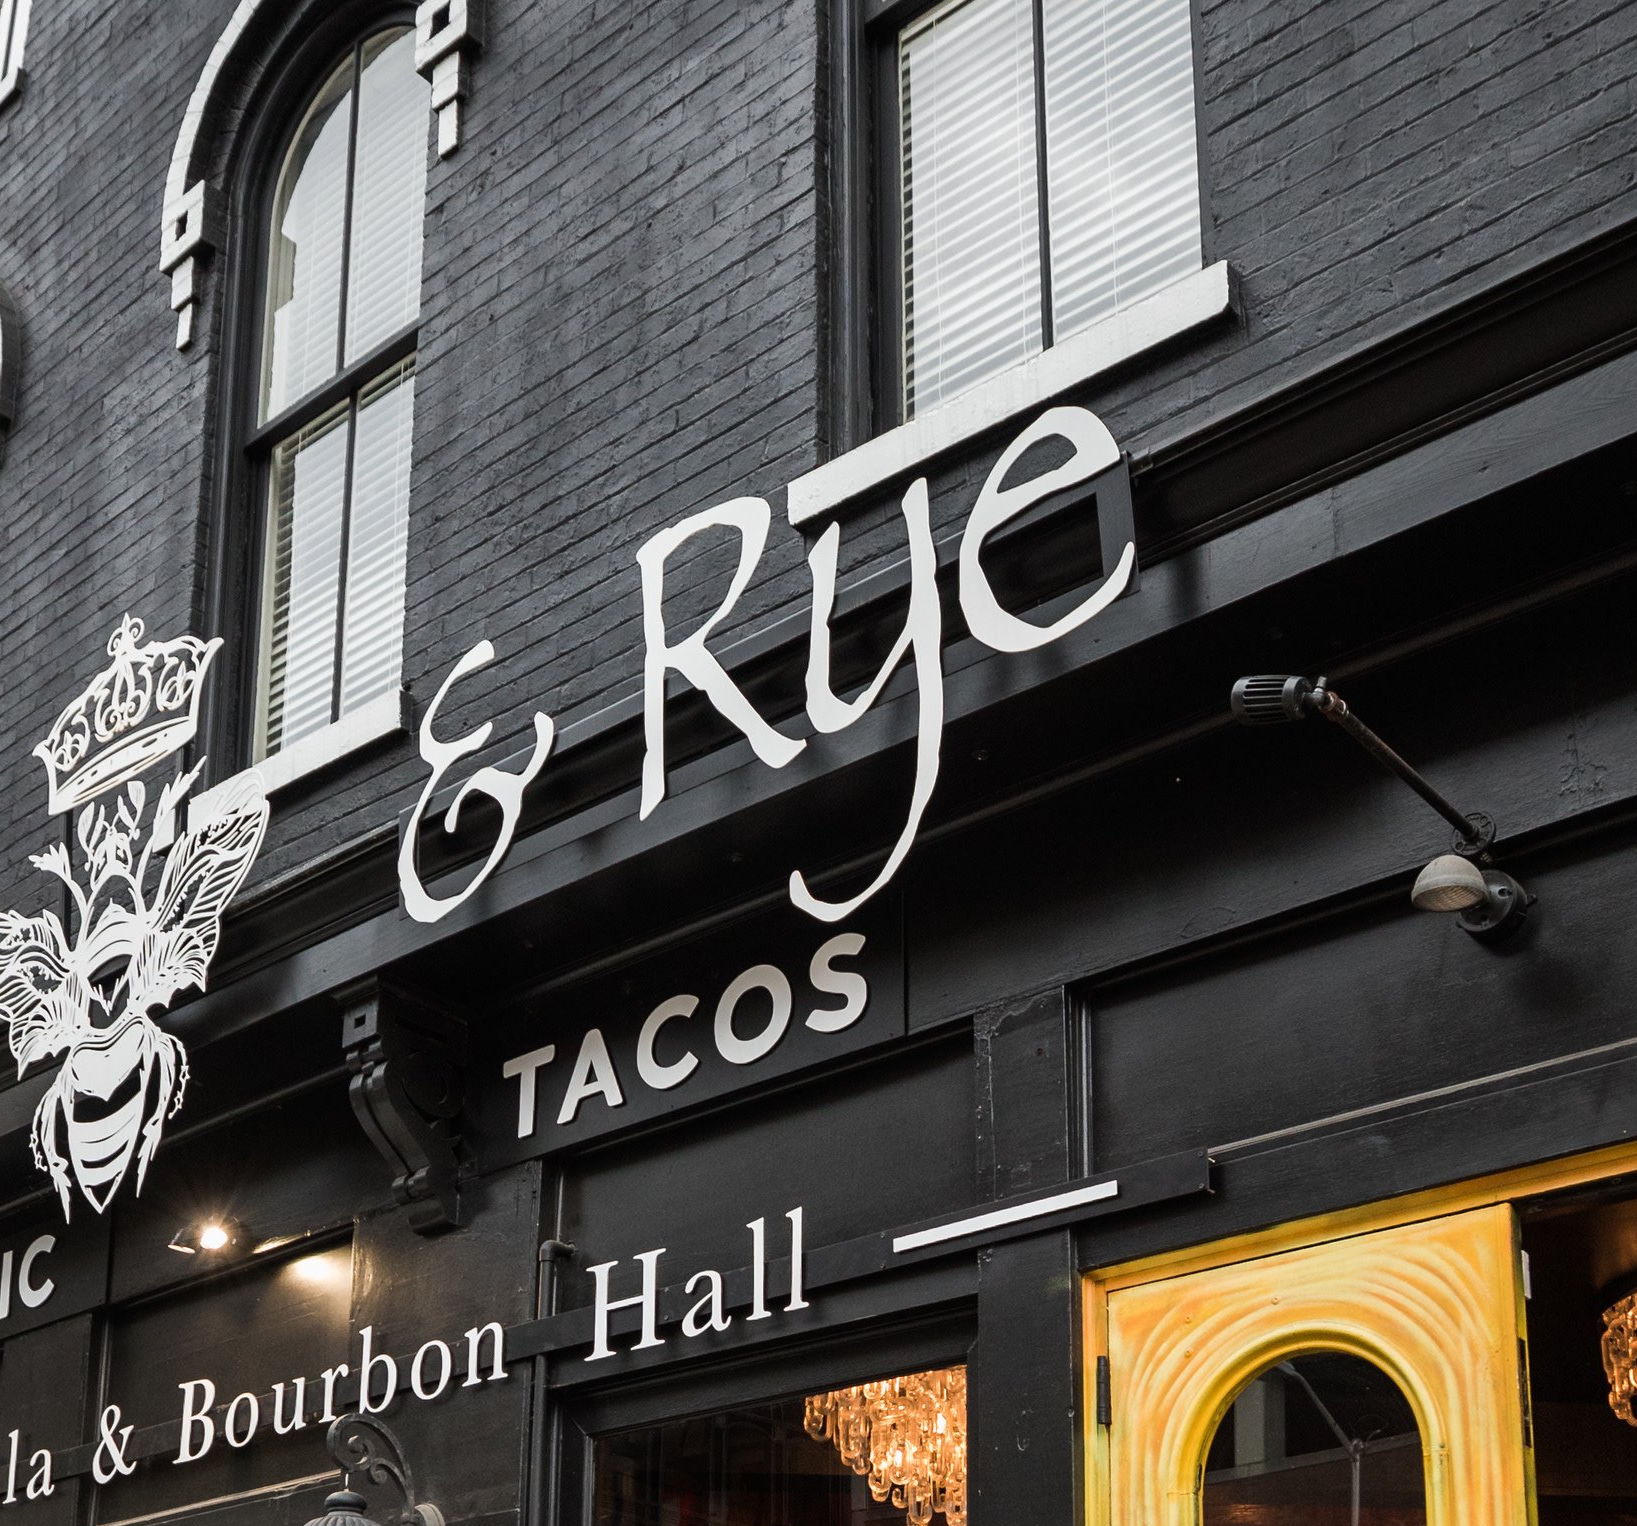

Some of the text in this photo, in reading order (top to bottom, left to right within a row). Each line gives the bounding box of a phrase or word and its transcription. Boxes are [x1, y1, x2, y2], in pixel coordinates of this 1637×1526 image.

[398, 639, 554, 923] &
[634, 405, 1134, 922] Rye
[502, 931, 868, 1138] TACOS
[92, 1403, 137, 1486] &
[174, 1317, 508, 1466] Bourbon
[582, 1205, 810, 1362] Hall
